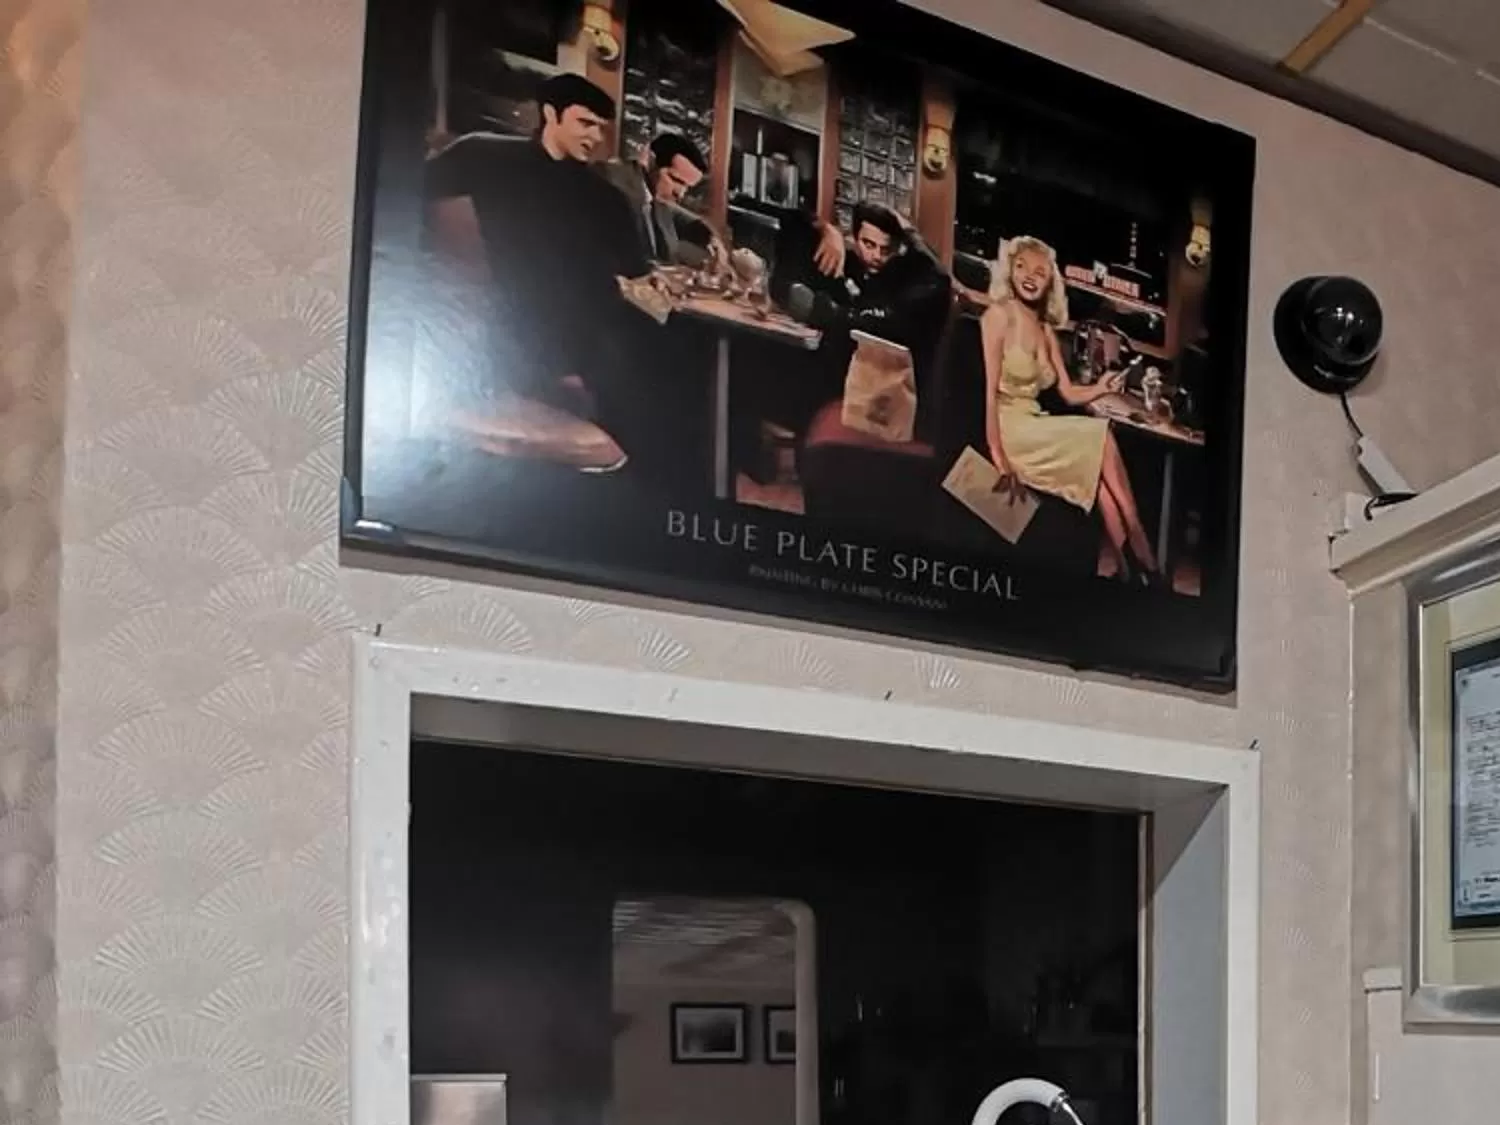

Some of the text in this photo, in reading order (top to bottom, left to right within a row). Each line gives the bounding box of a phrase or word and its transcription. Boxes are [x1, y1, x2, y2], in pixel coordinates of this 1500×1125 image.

[666, 510, 759, 551] BLUE
[776, 530, 878, 573] PLATE
[891, 553, 1020, 600] SPECIAL
